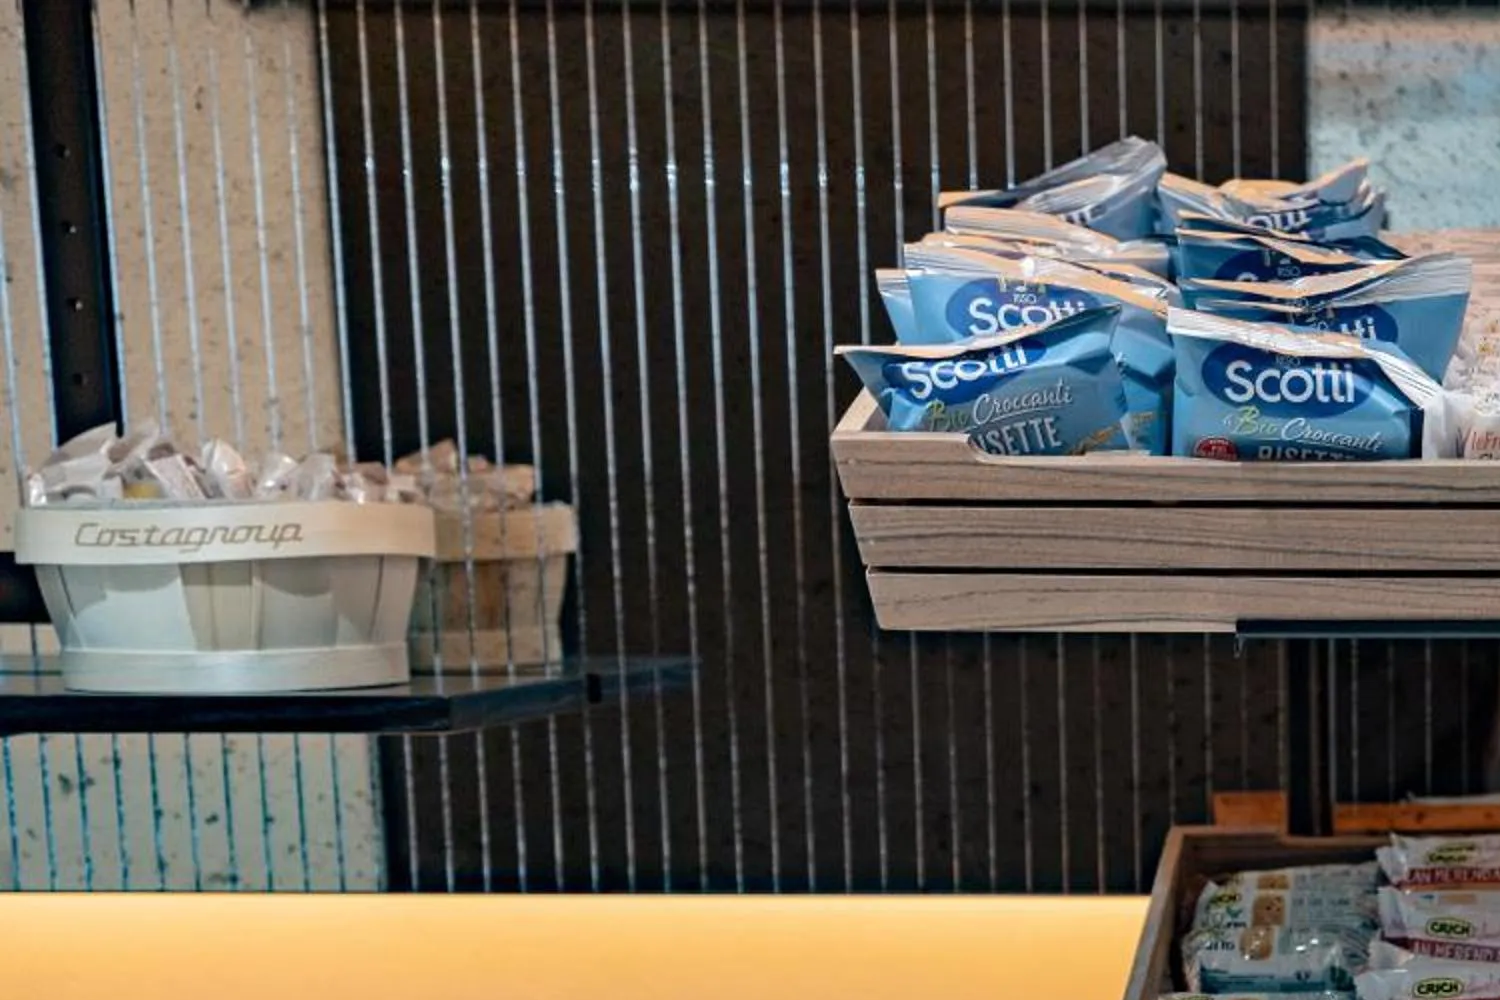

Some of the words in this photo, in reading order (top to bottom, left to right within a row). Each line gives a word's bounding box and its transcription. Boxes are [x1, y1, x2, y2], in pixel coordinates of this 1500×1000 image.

[972, 376, 1073, 426] Croccanti
[1223, 359, 1356, 403] Scotti
[976, 416, 1062, 455] ISETTE
[1230, 405, 1279, 434] Bio
[1280, 417, 1386, 453] Croccanti
[74, 521, 304, 555] Costagroup
[1417, 983, 1459, 995] CRICH
